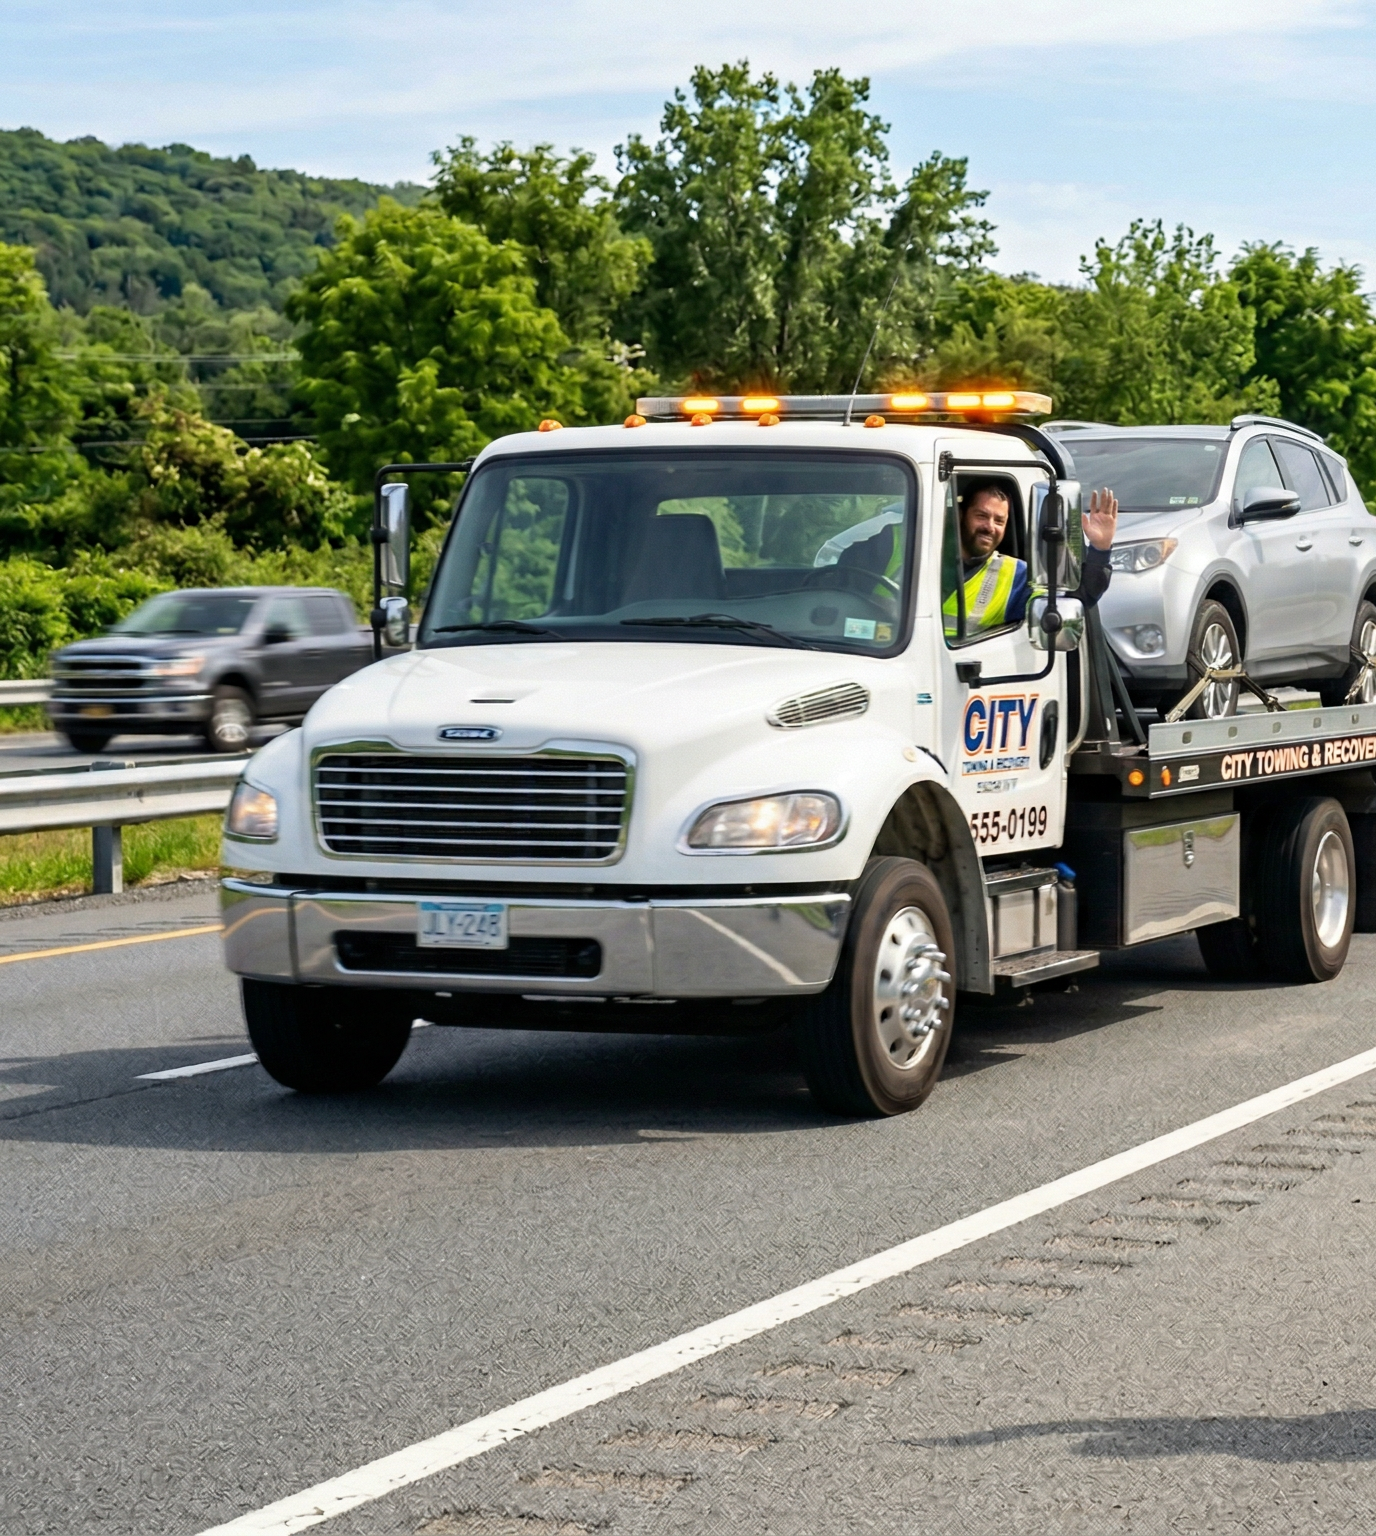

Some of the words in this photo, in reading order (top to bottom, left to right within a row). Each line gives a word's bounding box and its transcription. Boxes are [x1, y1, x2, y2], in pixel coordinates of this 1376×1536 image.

[963, 693, 1039, 756] CITY
[1221, 752, 1254, 780] CITY
[1256, 745, 1309, 774] TOWING
[1311, 743, 1321, 766] &
[970, 805, 1047, 844] 555-0199
